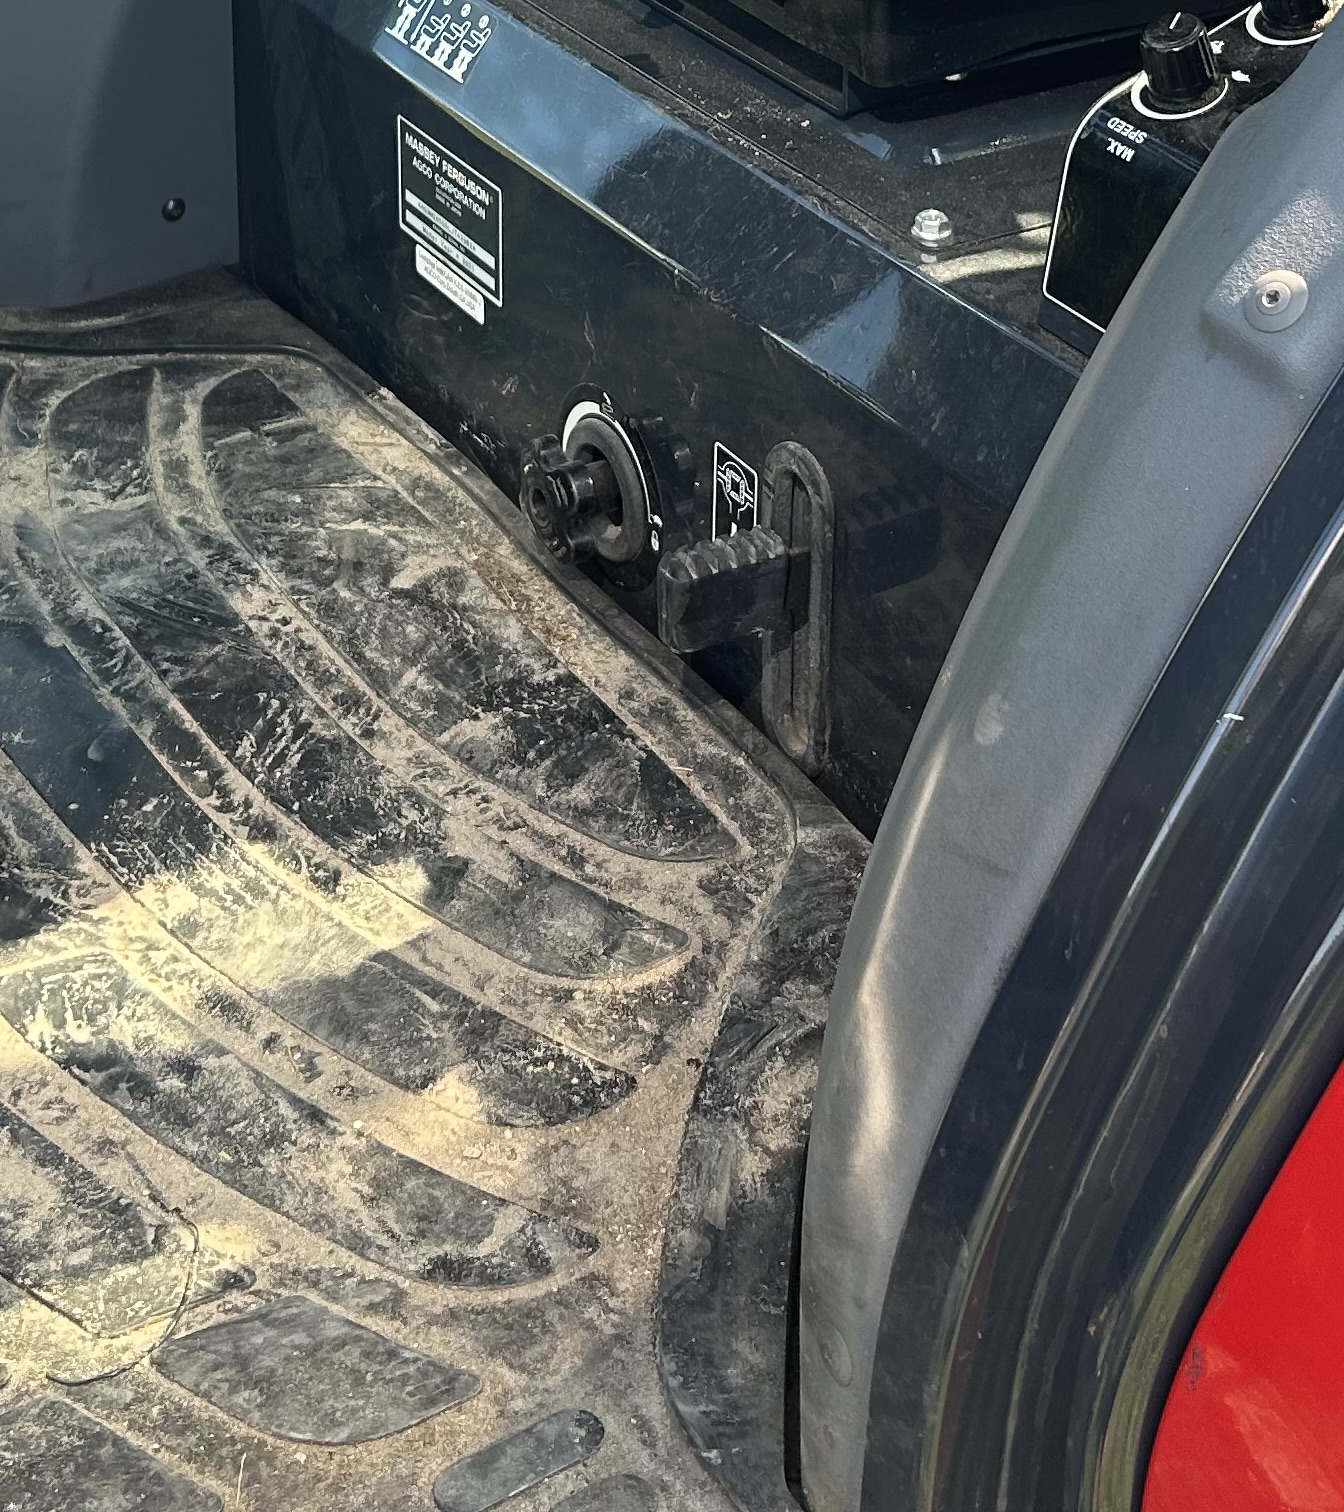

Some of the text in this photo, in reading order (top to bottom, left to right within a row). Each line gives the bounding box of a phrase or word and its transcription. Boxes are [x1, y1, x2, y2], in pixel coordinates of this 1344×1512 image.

[1107, 116, 1147, 144] SPEED
[405, 131, 441, 167] MASSEY
[412, 155, 433, 179] AGCO
[434, 172, 486, 220] CORPORATION
